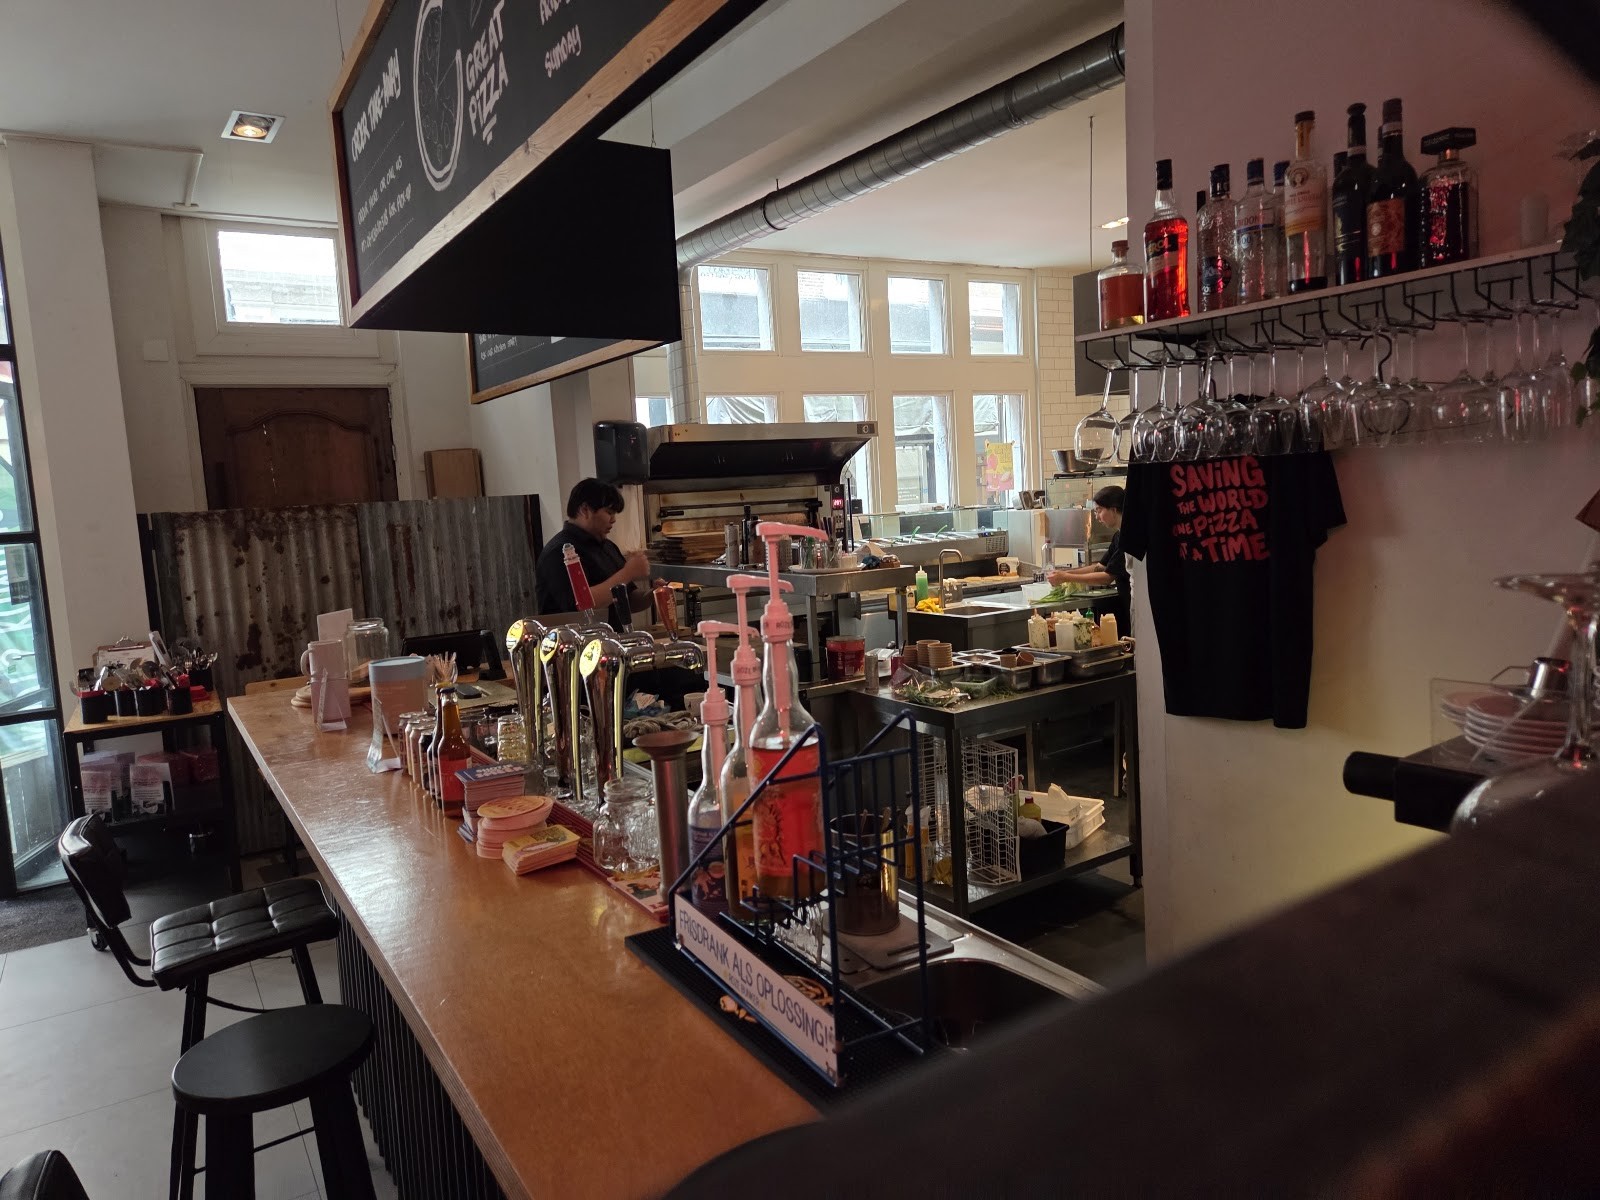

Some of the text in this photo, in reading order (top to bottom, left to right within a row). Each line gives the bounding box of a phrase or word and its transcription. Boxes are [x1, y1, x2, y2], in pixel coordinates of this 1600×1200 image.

[466, 0, 504, 91] GREAT
[545, 25, 581, 77] SUNDAY
[1177, 488, 1269, 514] THE WORLD
[679, 909, 828, 1052] FRISDRANK ALS OPLOSSING!
